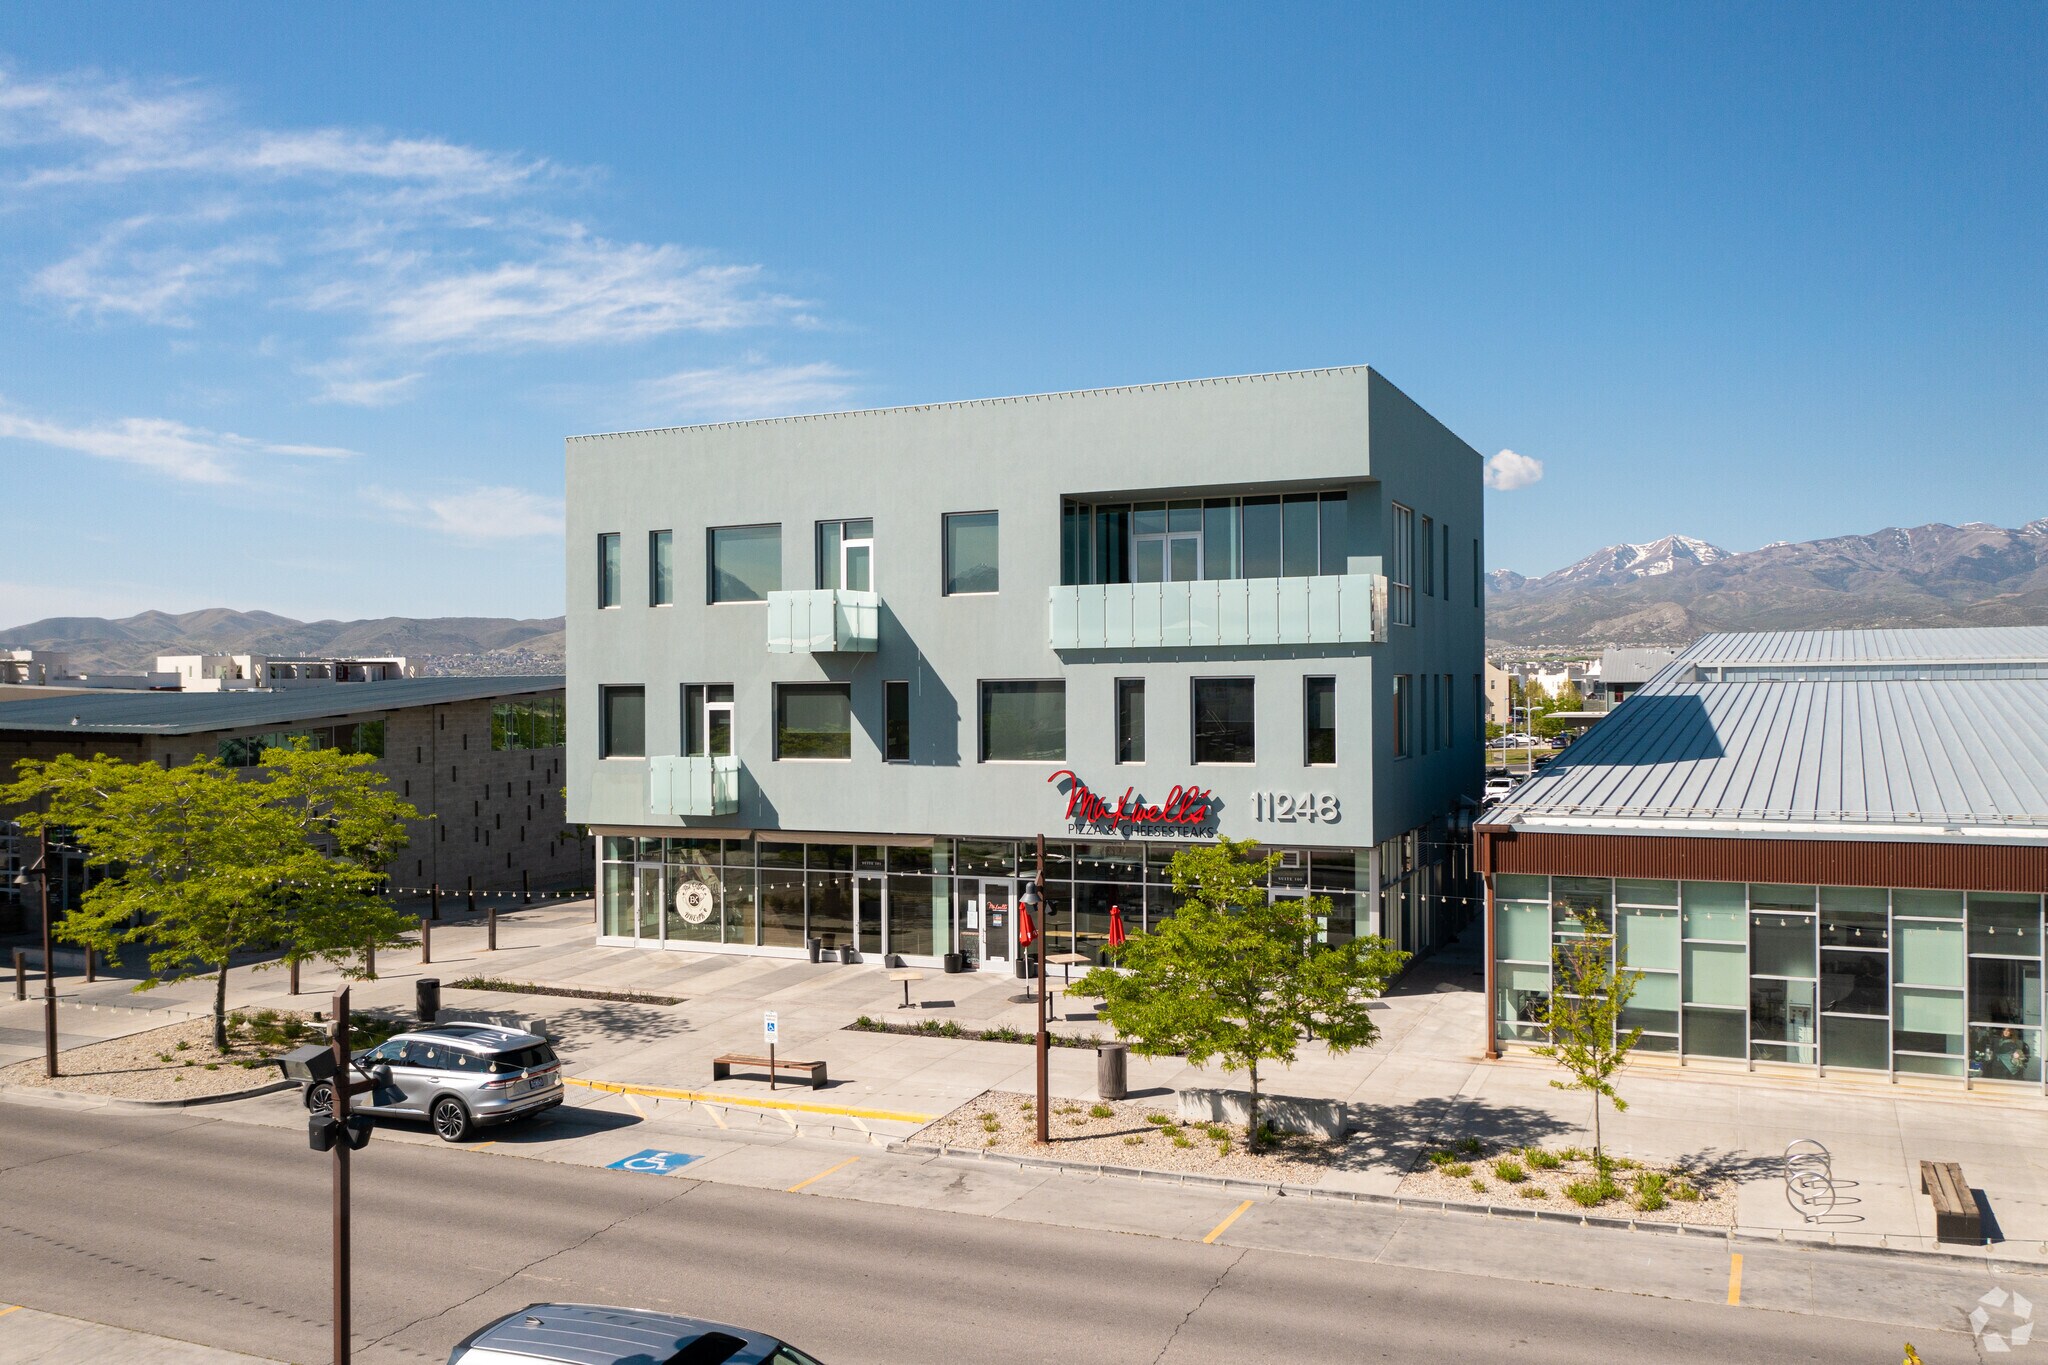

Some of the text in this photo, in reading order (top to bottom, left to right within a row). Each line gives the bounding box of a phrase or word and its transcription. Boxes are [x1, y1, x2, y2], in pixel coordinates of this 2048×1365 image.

[1047, 769, 1212, 830] Maxwell's
[1251, 791, 1339, 823] 11248
[1068, 823, 1214, 839] PIZZA & CHEESESTEAKS
